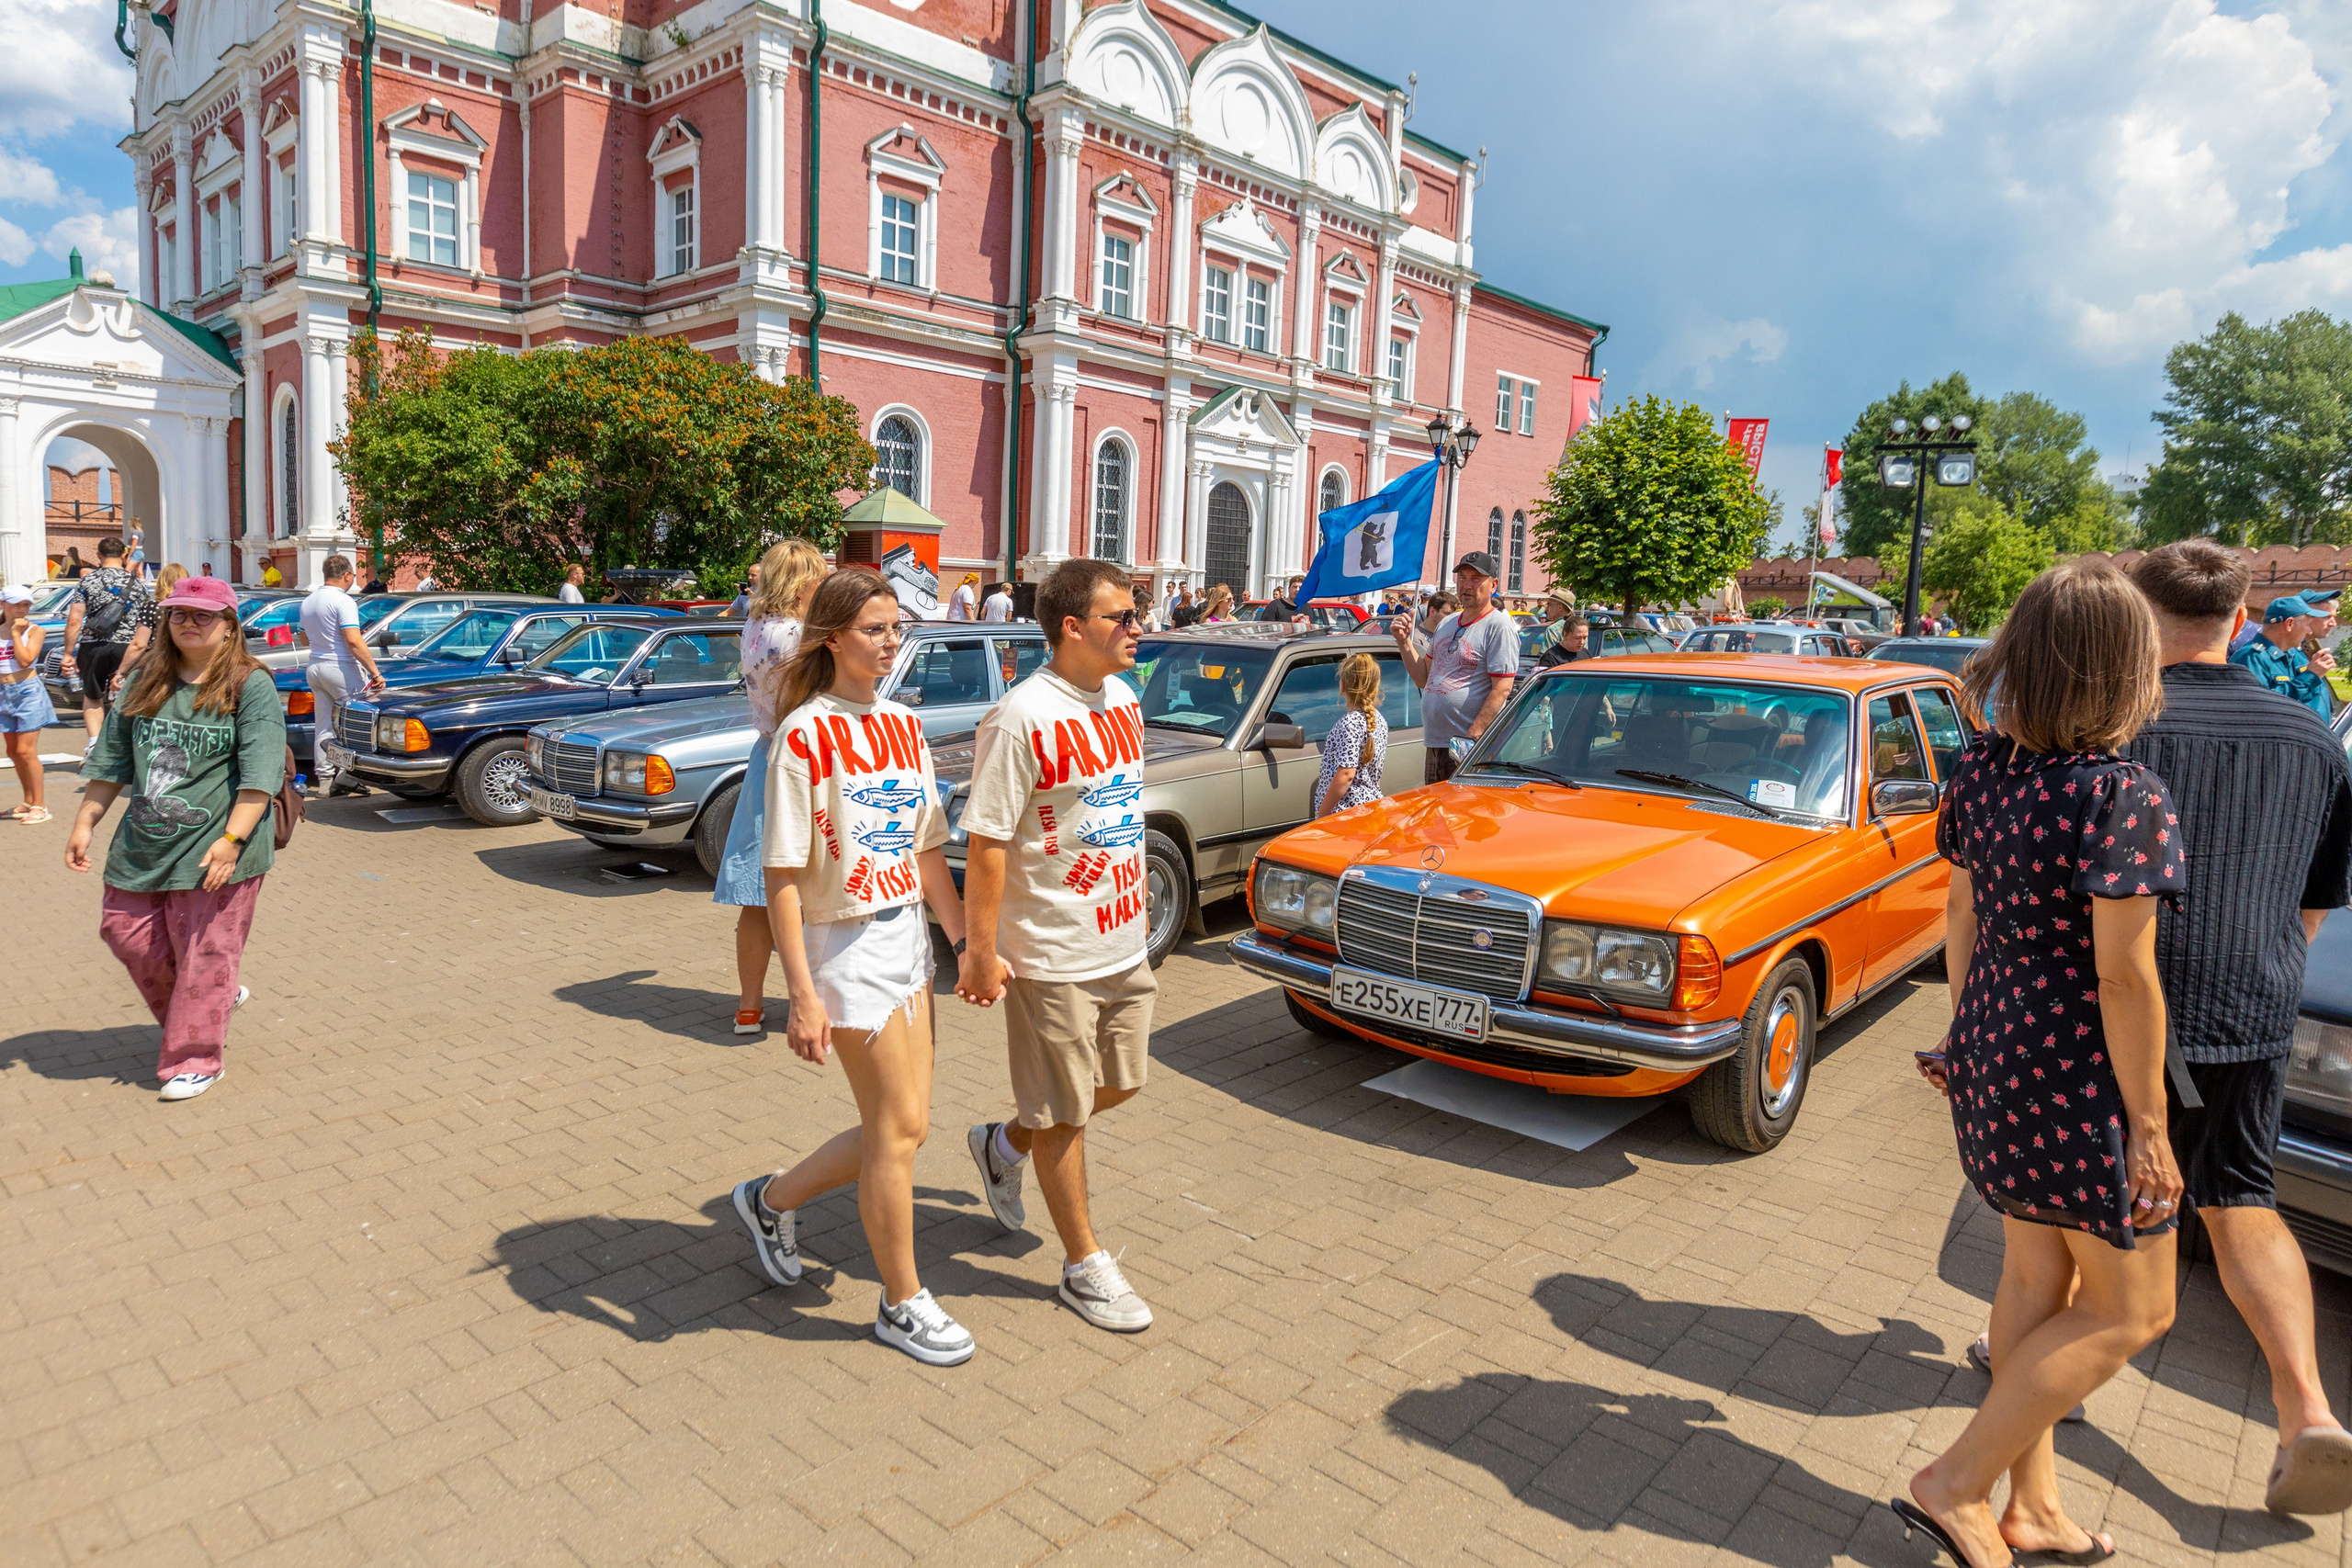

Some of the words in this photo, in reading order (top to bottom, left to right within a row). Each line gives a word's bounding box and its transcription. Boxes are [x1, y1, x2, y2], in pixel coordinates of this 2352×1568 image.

[1747, 423, 1766, 488] ВЫСТА
[550, 796, 571, 815] 8998
[1037, 805, 1057, 832] FRESH
[1044, 836, 1059, 855] FISH
[1148, 840, 1173, 855] SLAVED
[843, 855, 872, 897] SUNDAY
[876, 861, 917, 902] FISH
[1062, 852, 1093, 889] SUNDAY
[1075, 850, 1112, 897] SATURDAY
[1112, 852, 1141, 895] FISH
[1340, 981, 1430, 1022] Е255ХЕ
[1437, 996, 1476, 1023] 777
[1444, 1020, 1464, 1032] RUS
